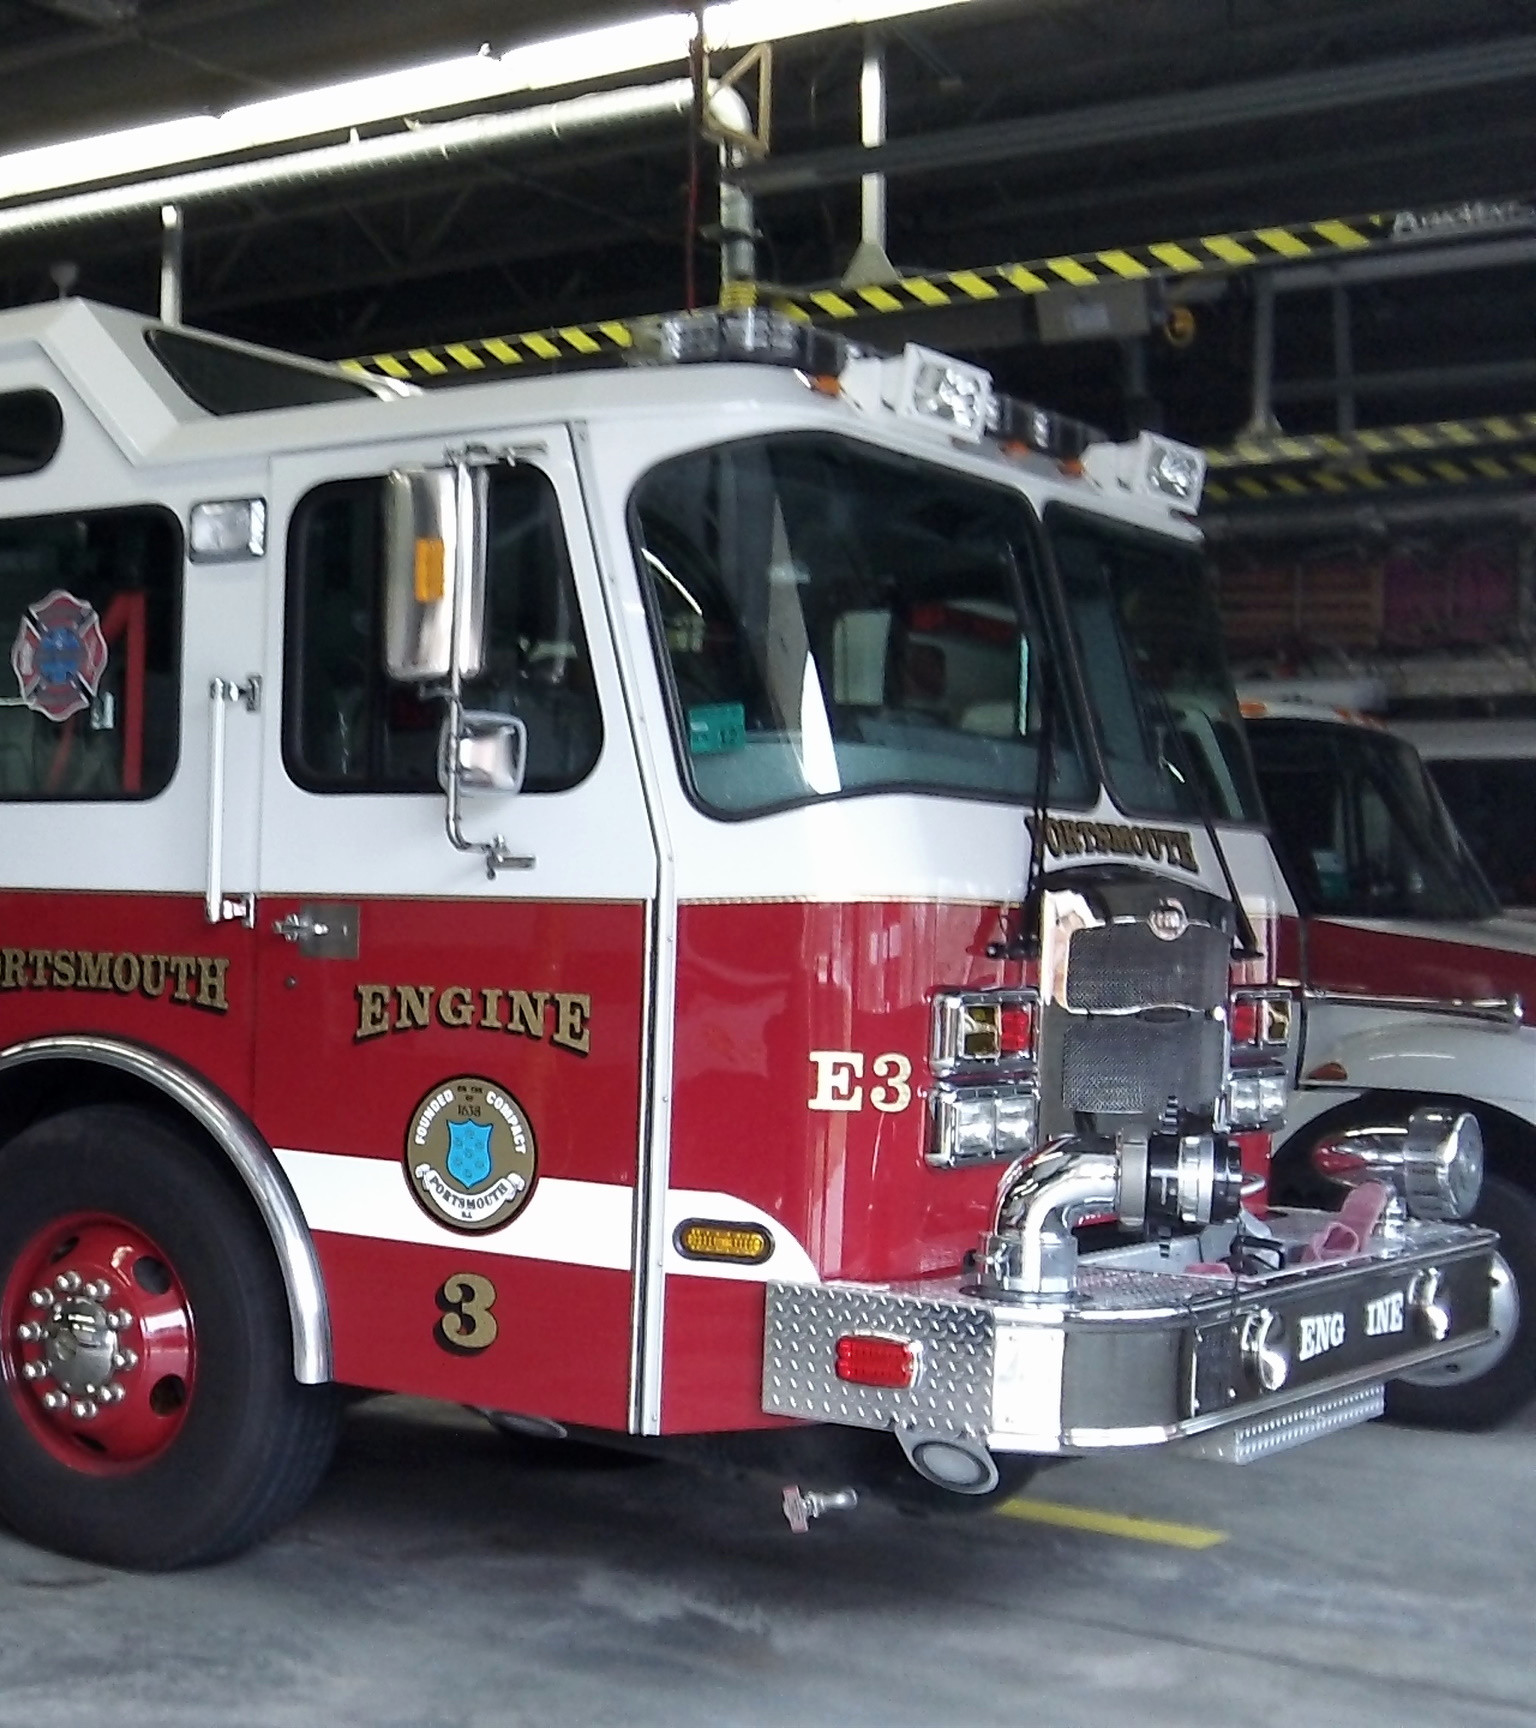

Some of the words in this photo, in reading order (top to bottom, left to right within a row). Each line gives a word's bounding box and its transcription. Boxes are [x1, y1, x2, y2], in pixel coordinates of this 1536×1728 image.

[354, 983, 592, 1057] ENGINE
[807, 1050, 913, 1113] E3
[415, 1088, 454, 1145] FOUNDED
[486, 1090, 526, 1154] COMPACT
[429, 1175, 508, 1210] PORTSMOUTH
[434, 1272, 498, 1356] 3
[1299, 1312, 1345, 1361] ENG
[1366, 1291, 1404, 1336] INE
